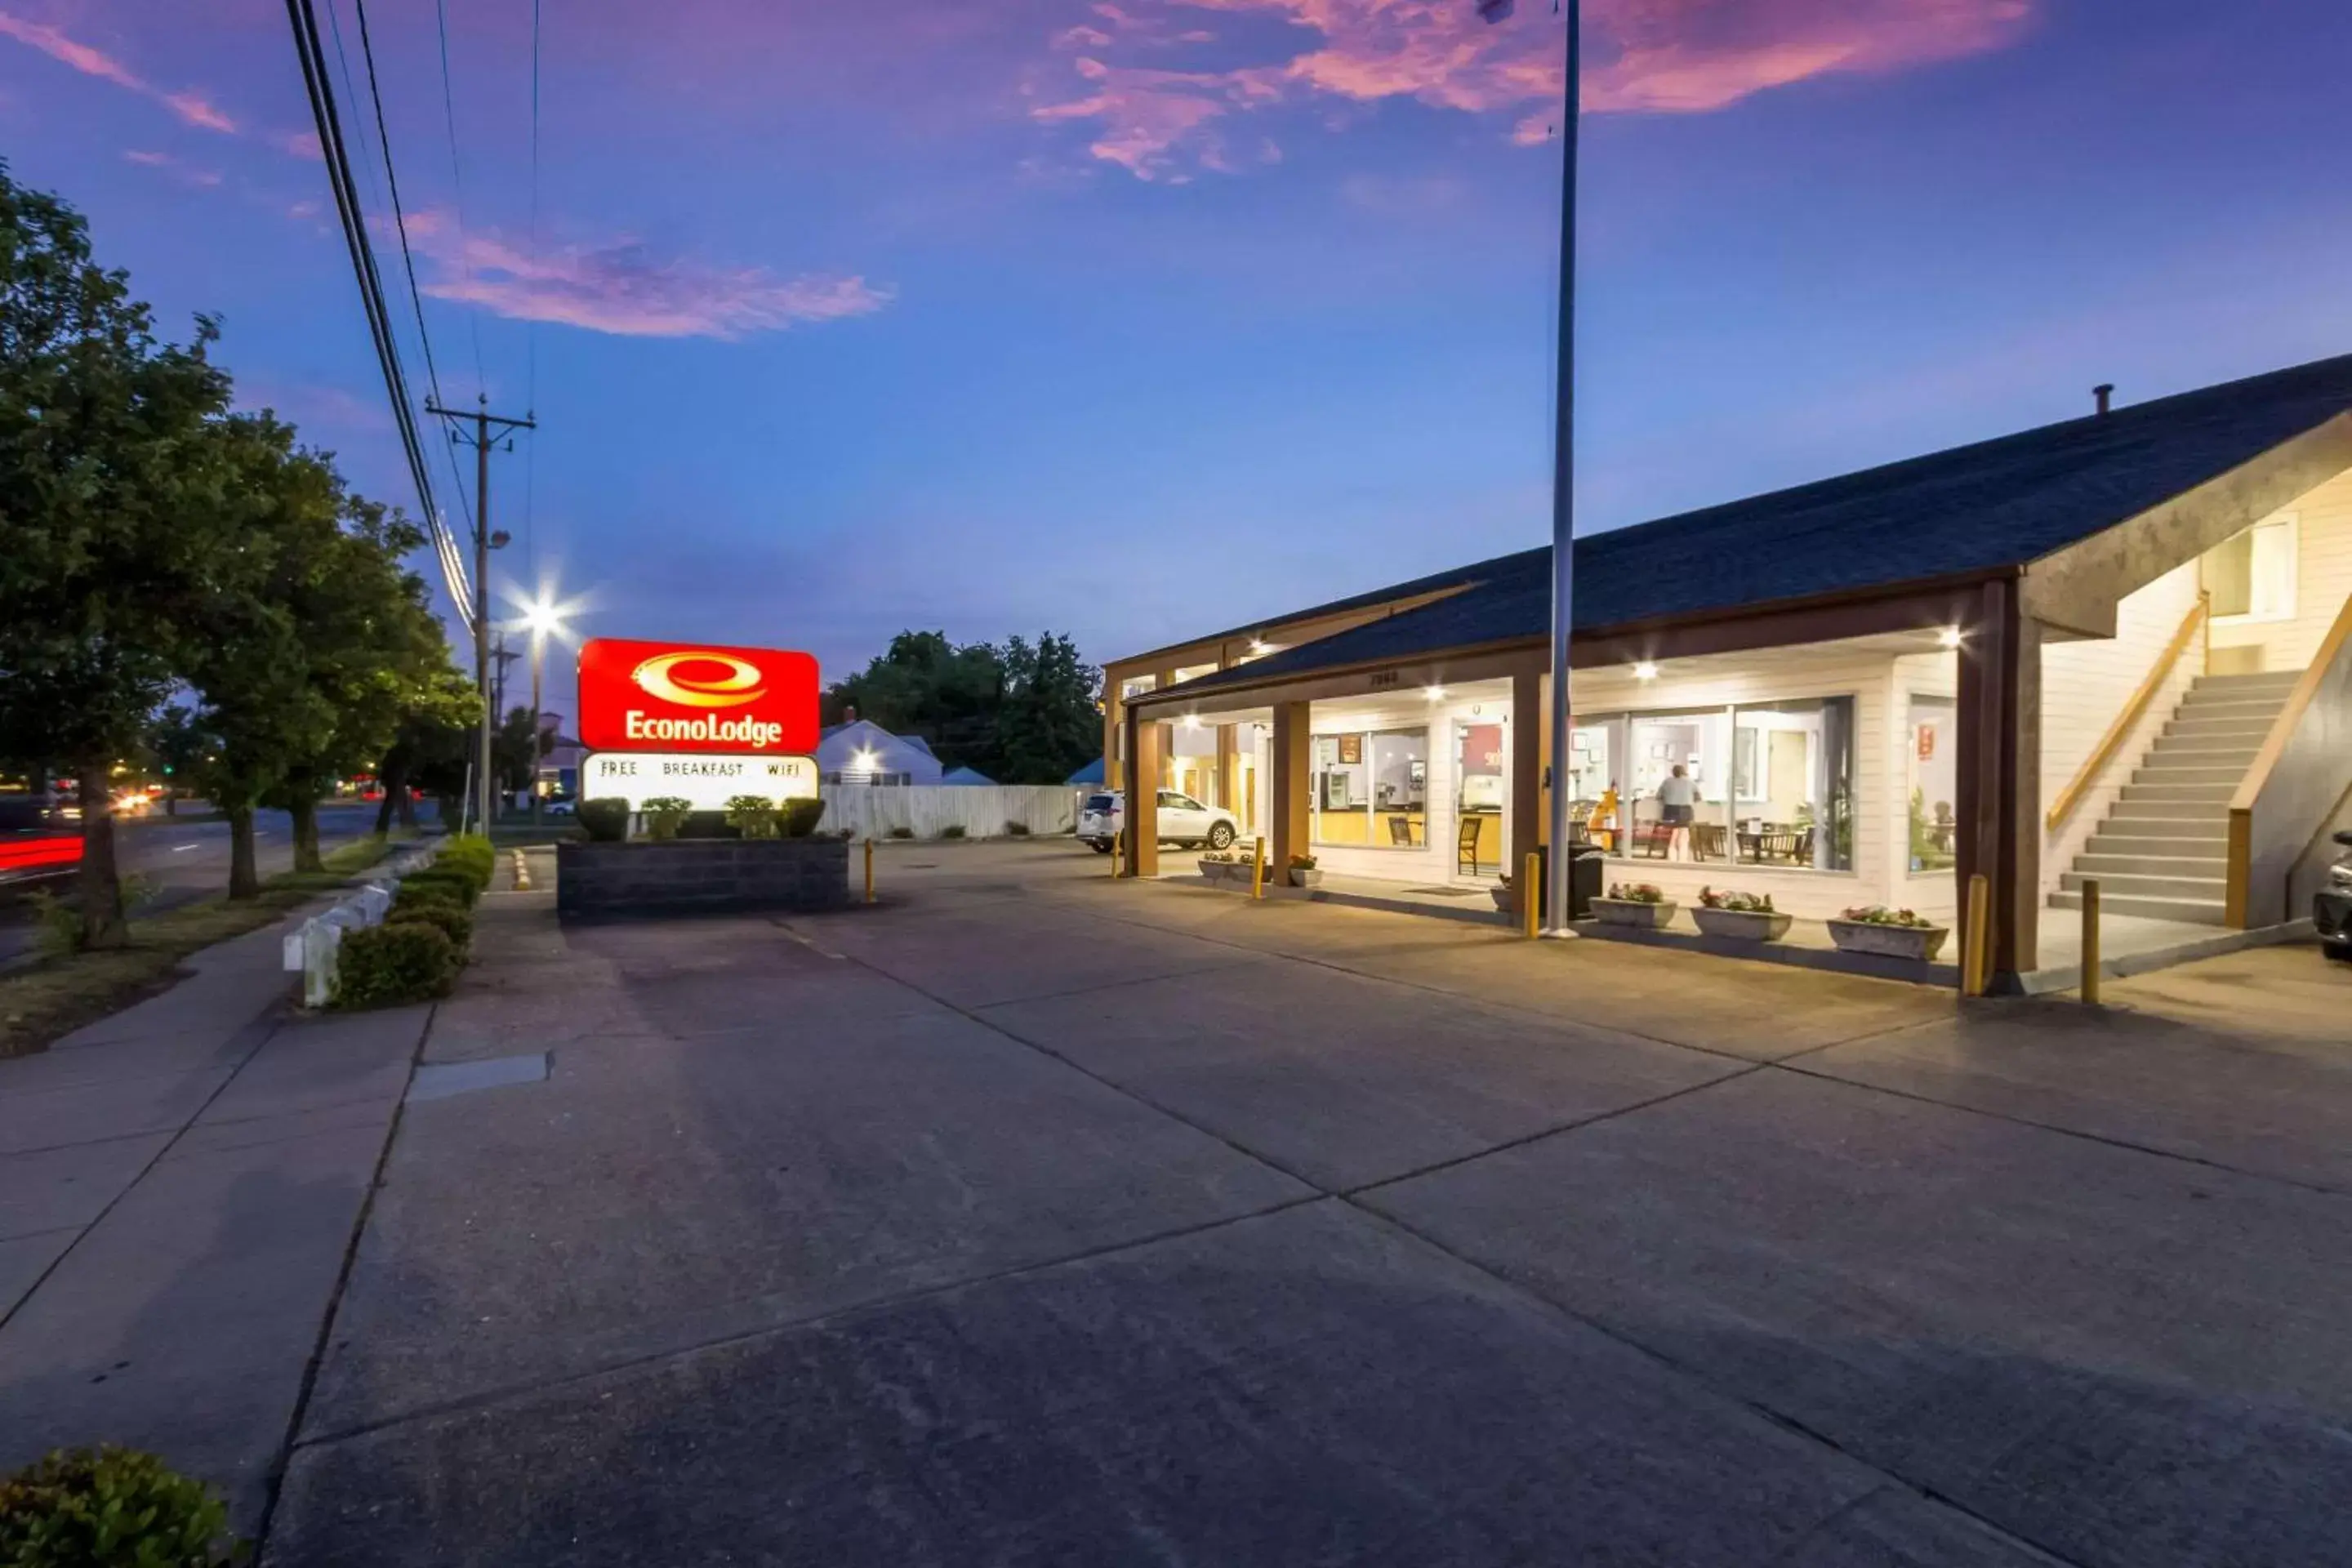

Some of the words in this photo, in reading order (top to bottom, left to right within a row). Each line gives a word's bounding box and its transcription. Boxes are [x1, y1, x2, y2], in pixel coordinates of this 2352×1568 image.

[626, 710, 782, 747] EconoLodge
[601, 760, 637, 777] FREE
[663, 762, 742, 777] BREAKFAST
[768, 764, 800, 775] WIFI
